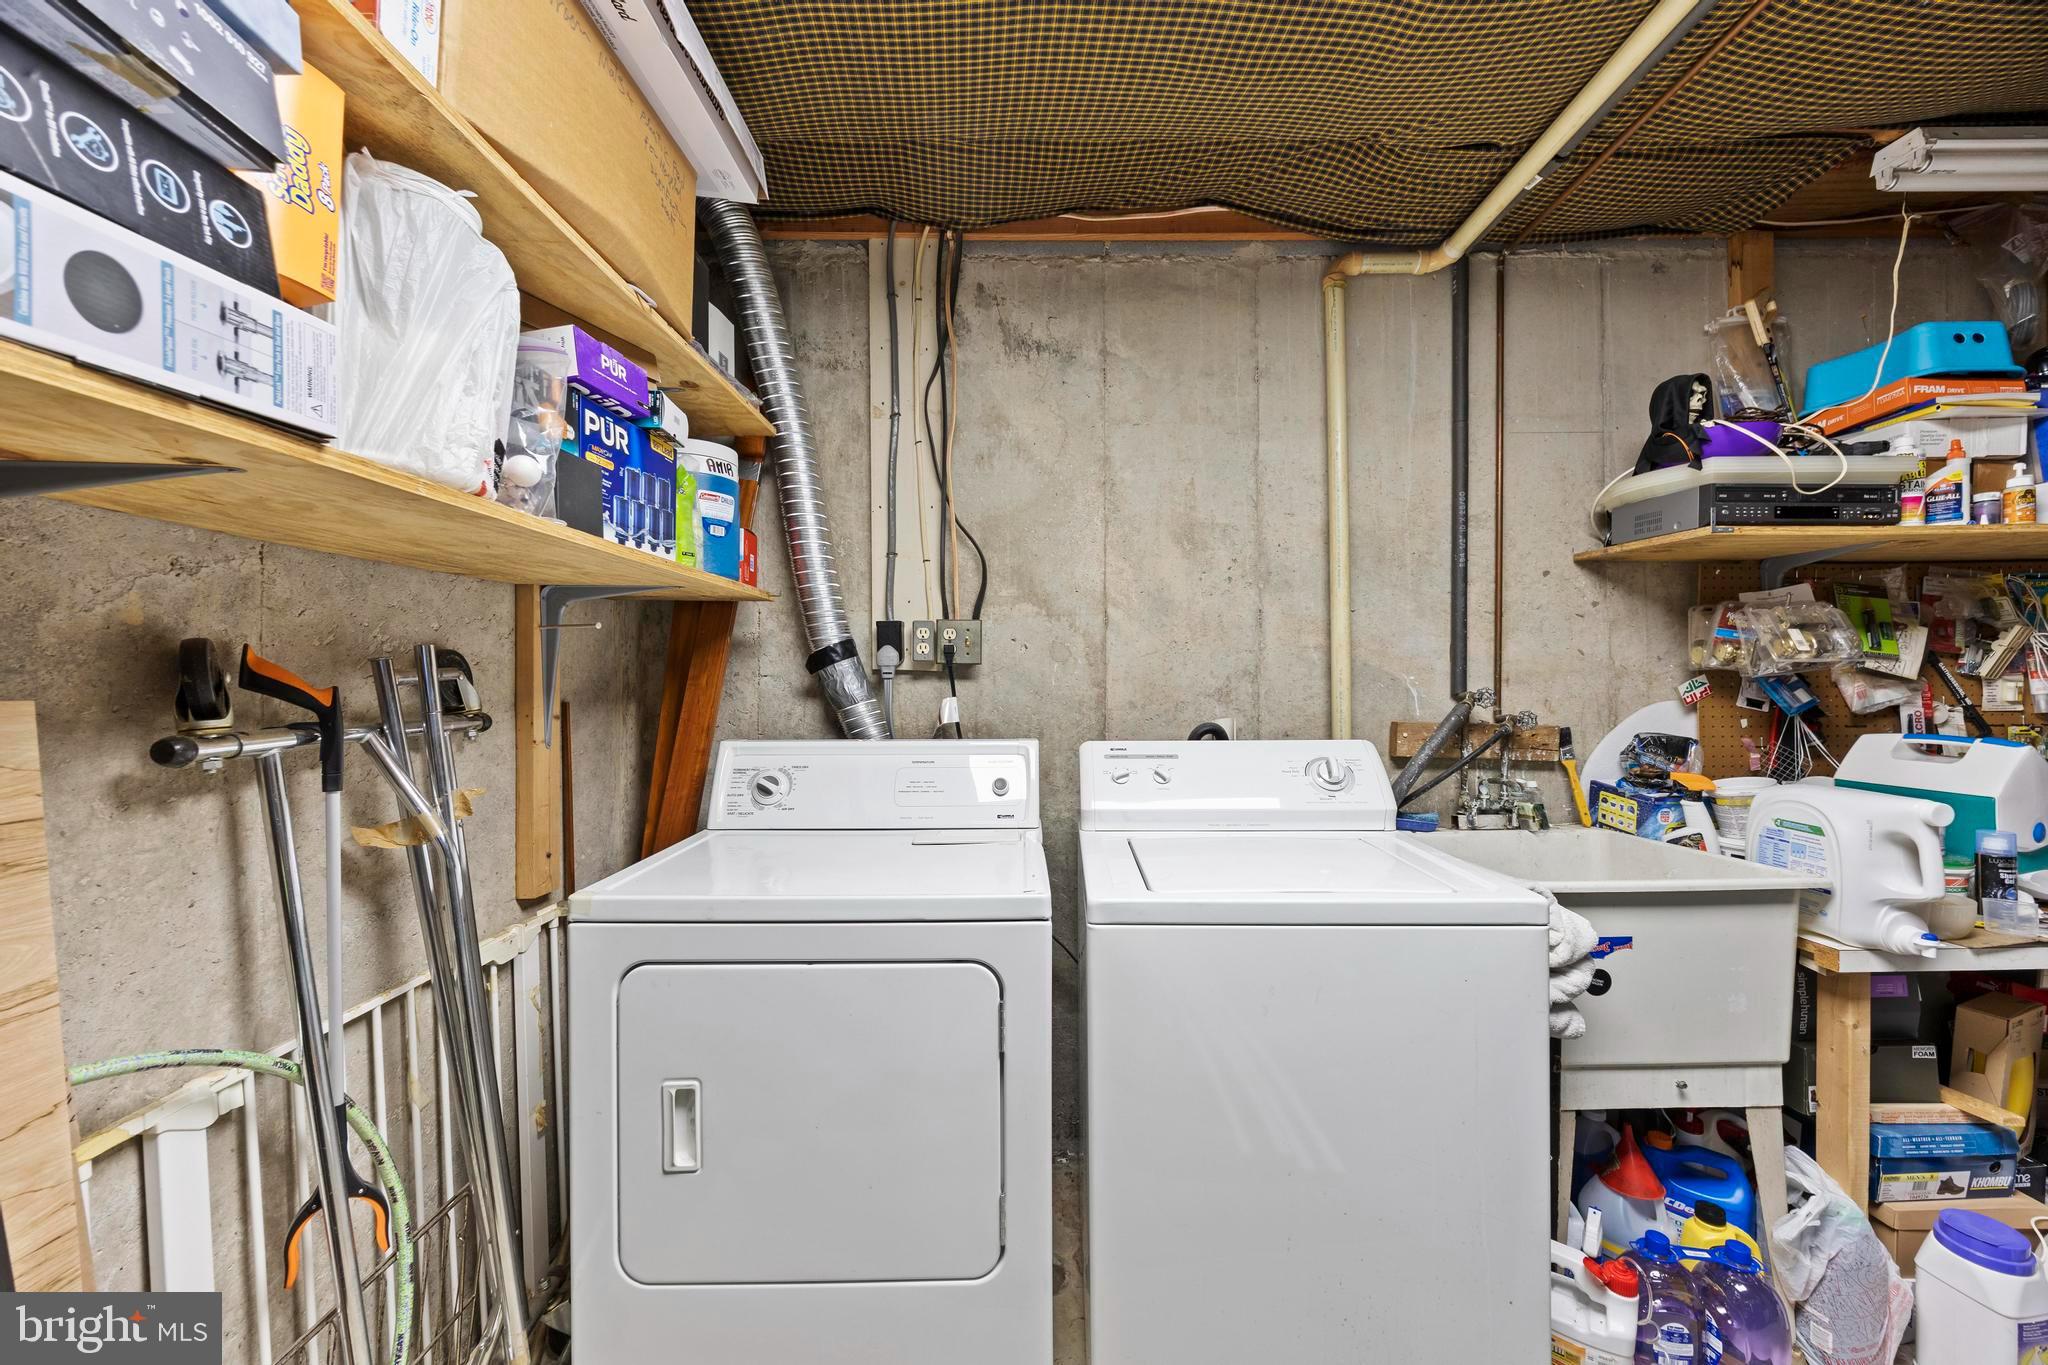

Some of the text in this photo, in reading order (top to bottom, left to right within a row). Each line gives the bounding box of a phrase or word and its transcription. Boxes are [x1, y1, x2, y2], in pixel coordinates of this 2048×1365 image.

[286, 125, 315, 214] Daddy
[316, 161, 335, 213] 8 Pack
[1913, 385, 1945, 394] FRAM
[1926, 492, 1961, 502] GLUE-ALL
[1797, 971, 1809, 1035] simplehuman
[1971, 1176, 2011, 1188] KHOMBU
